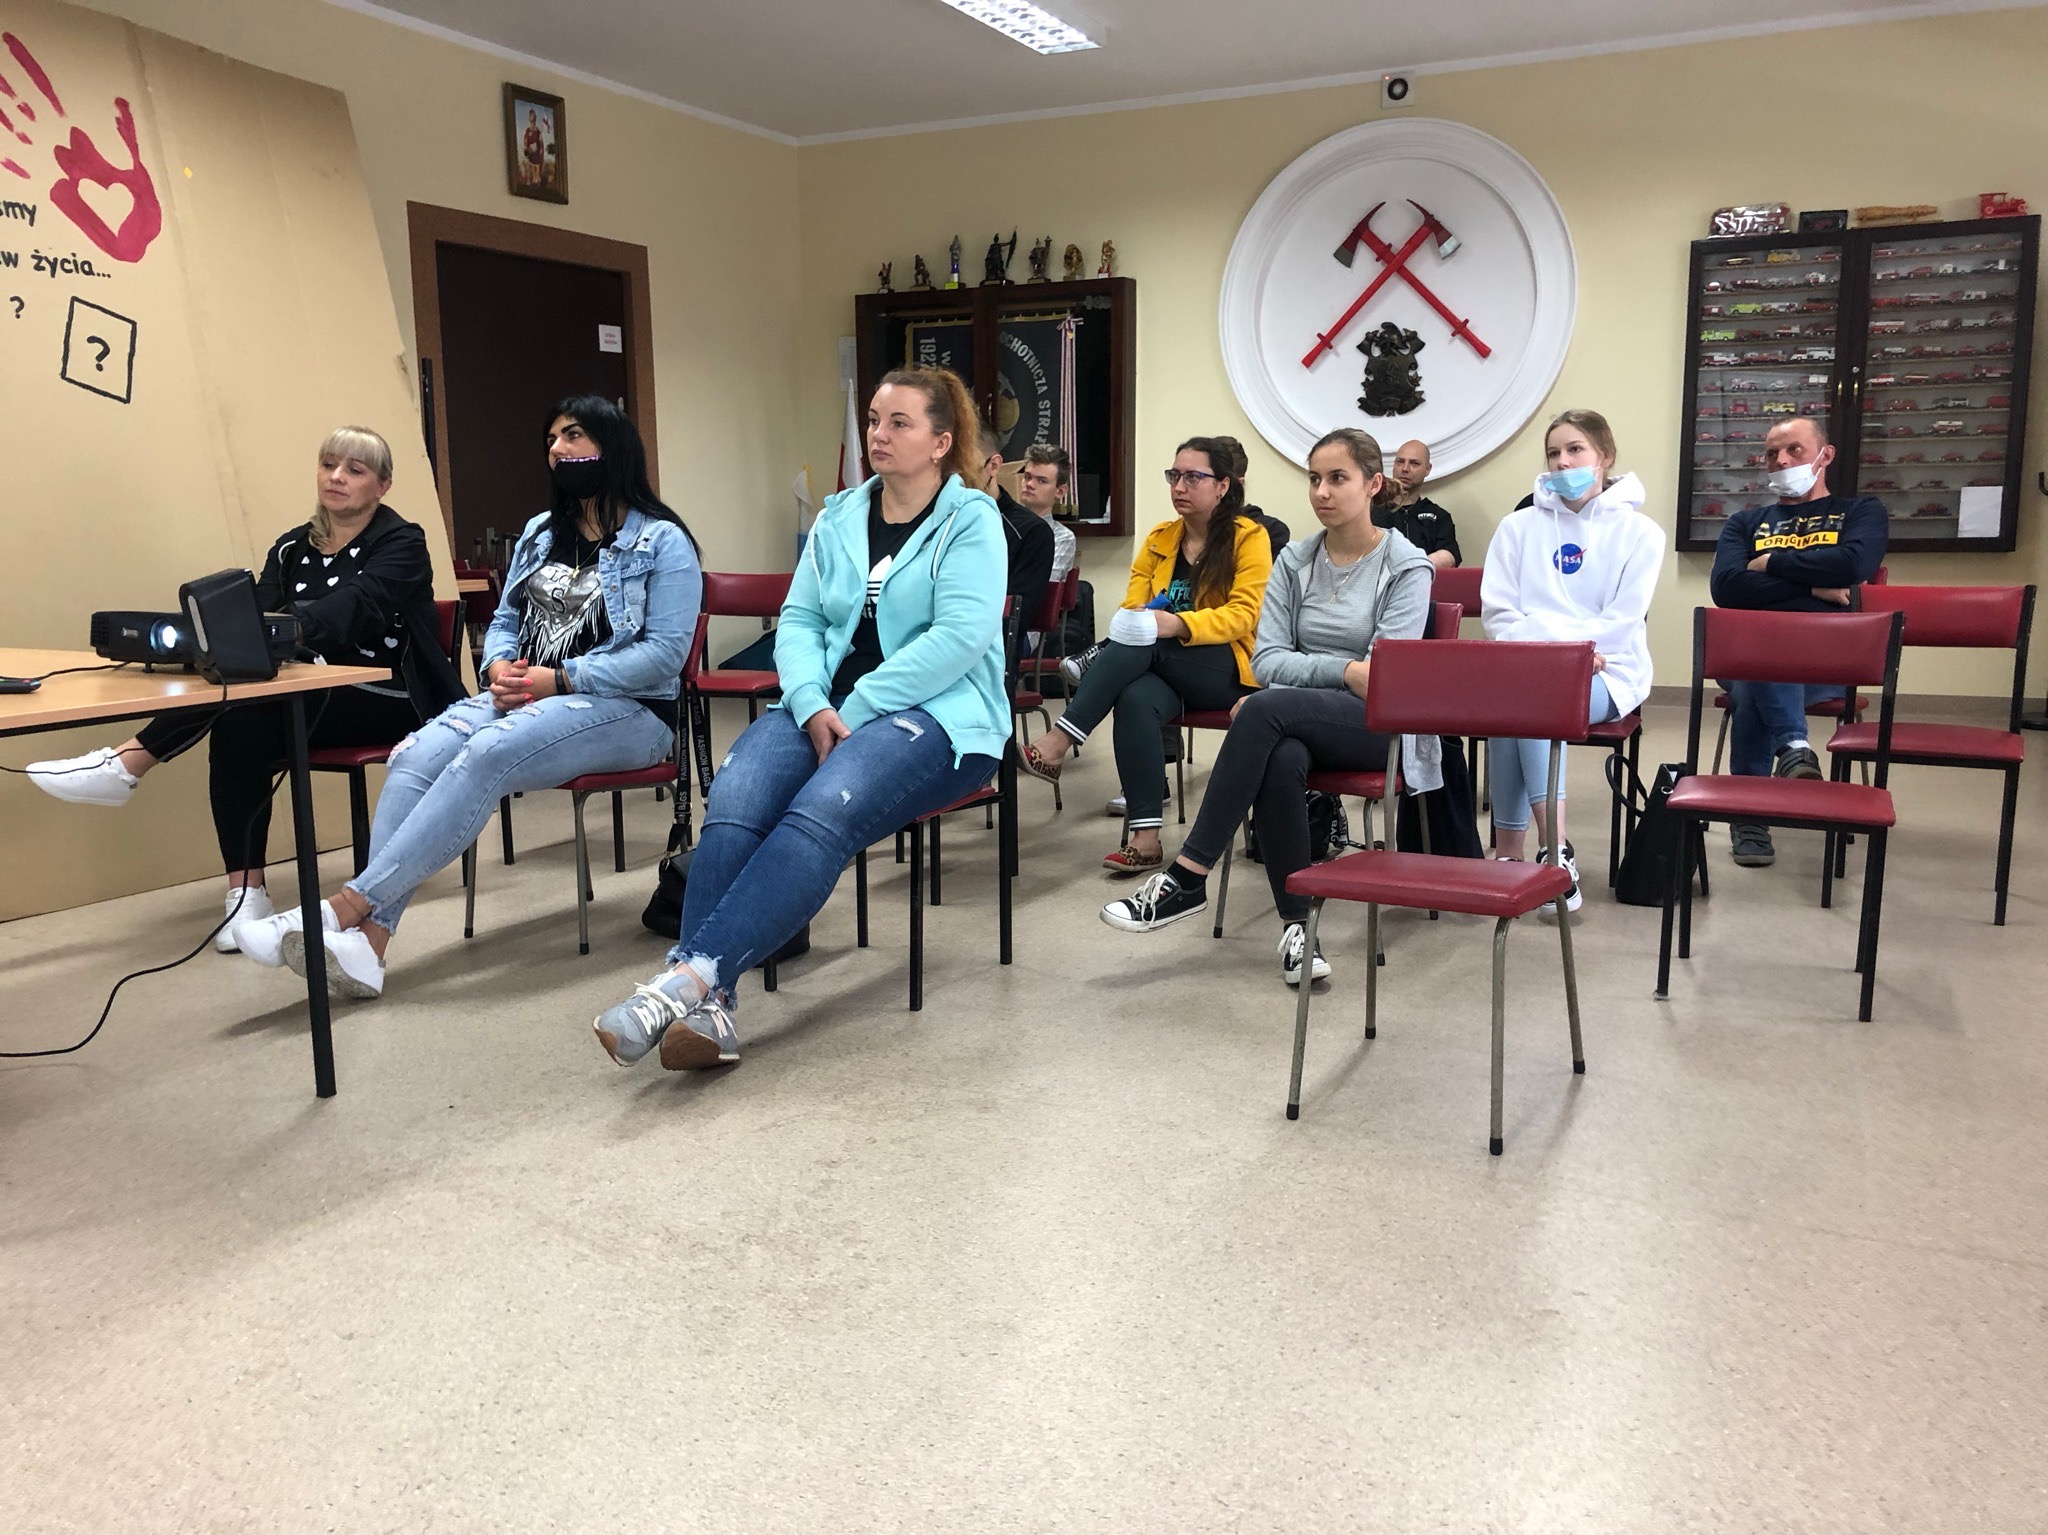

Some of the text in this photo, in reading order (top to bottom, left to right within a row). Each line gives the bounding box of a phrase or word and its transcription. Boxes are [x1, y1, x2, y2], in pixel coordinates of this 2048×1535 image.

[0, 248, 111, 279] w życia...
[86, 335, 110, 372] ?
[1000, 331, 1049, 395] OCHOTNICZA
[1763, 533, 1831, 548] ORIGINAL
[697, 735, 712, 787] FASHION BAGS
